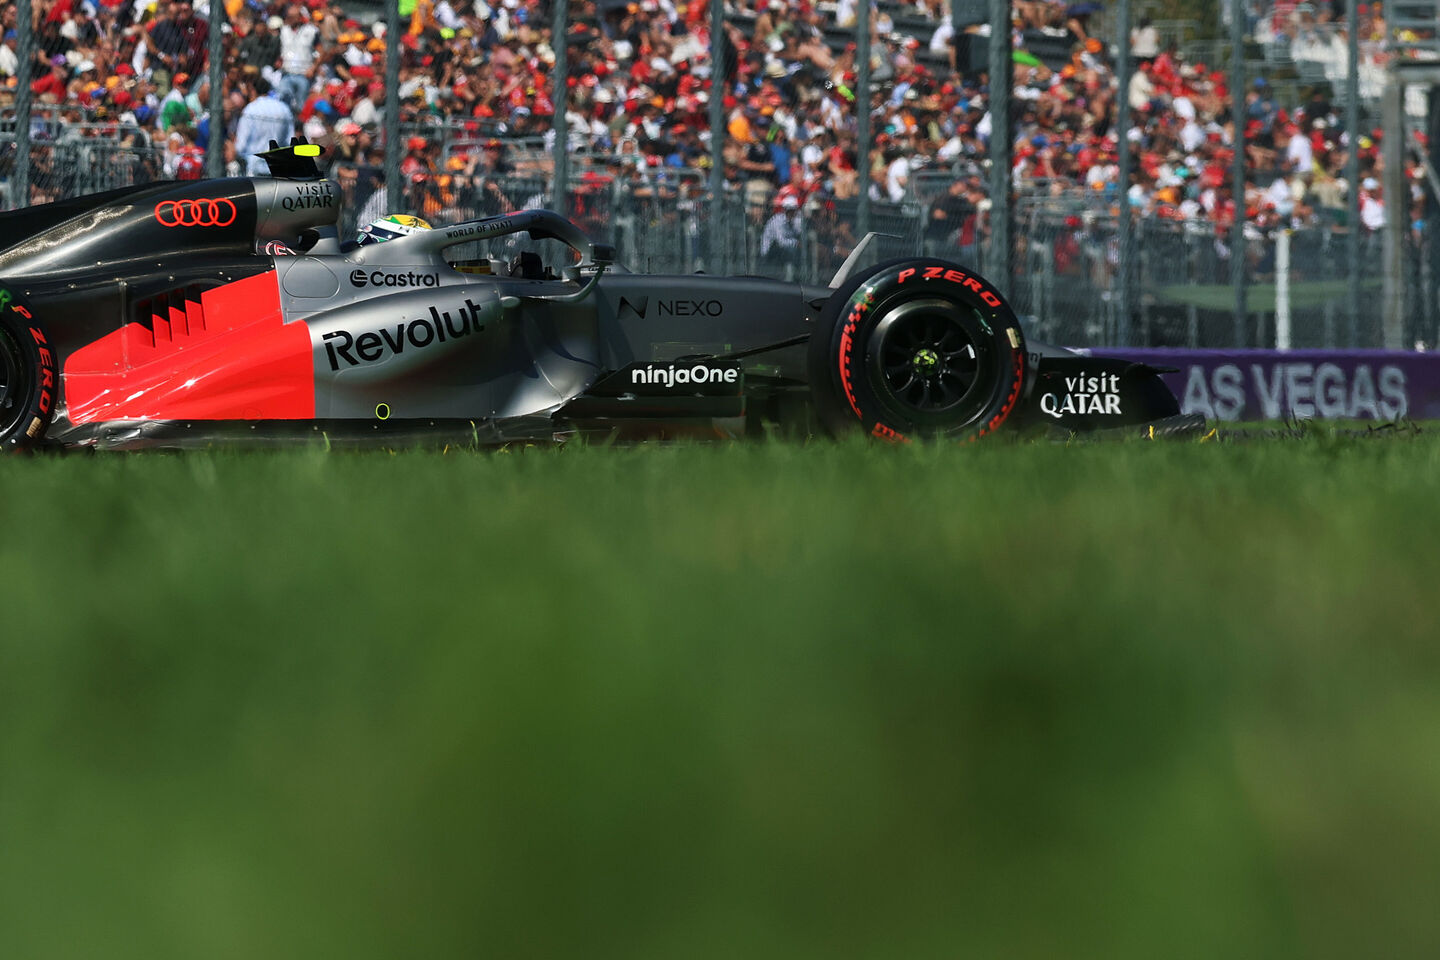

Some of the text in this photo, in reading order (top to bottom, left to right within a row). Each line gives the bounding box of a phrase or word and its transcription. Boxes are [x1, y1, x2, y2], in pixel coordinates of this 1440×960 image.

[295, 183, 332, 195] visit
[281, 195, 333, 212] QATAR
[446, 220, 513, 239] WORLD OF HYATT
[370, 271, 440, 288] Castrol
[897, 266, 1004, 308] P ZERO
[658, 299, 723, 317] NEXO
[321, 298, 485, 372] Revolut
[10, 304, 55, 415] P ZERO
[631, 365, 739, 388] ninjaOne
[1064, 371, 1120, 393] visit
[1251, 363, 1408, 420] VEGAS
[1040, 392, 1122, 418] QATAR
